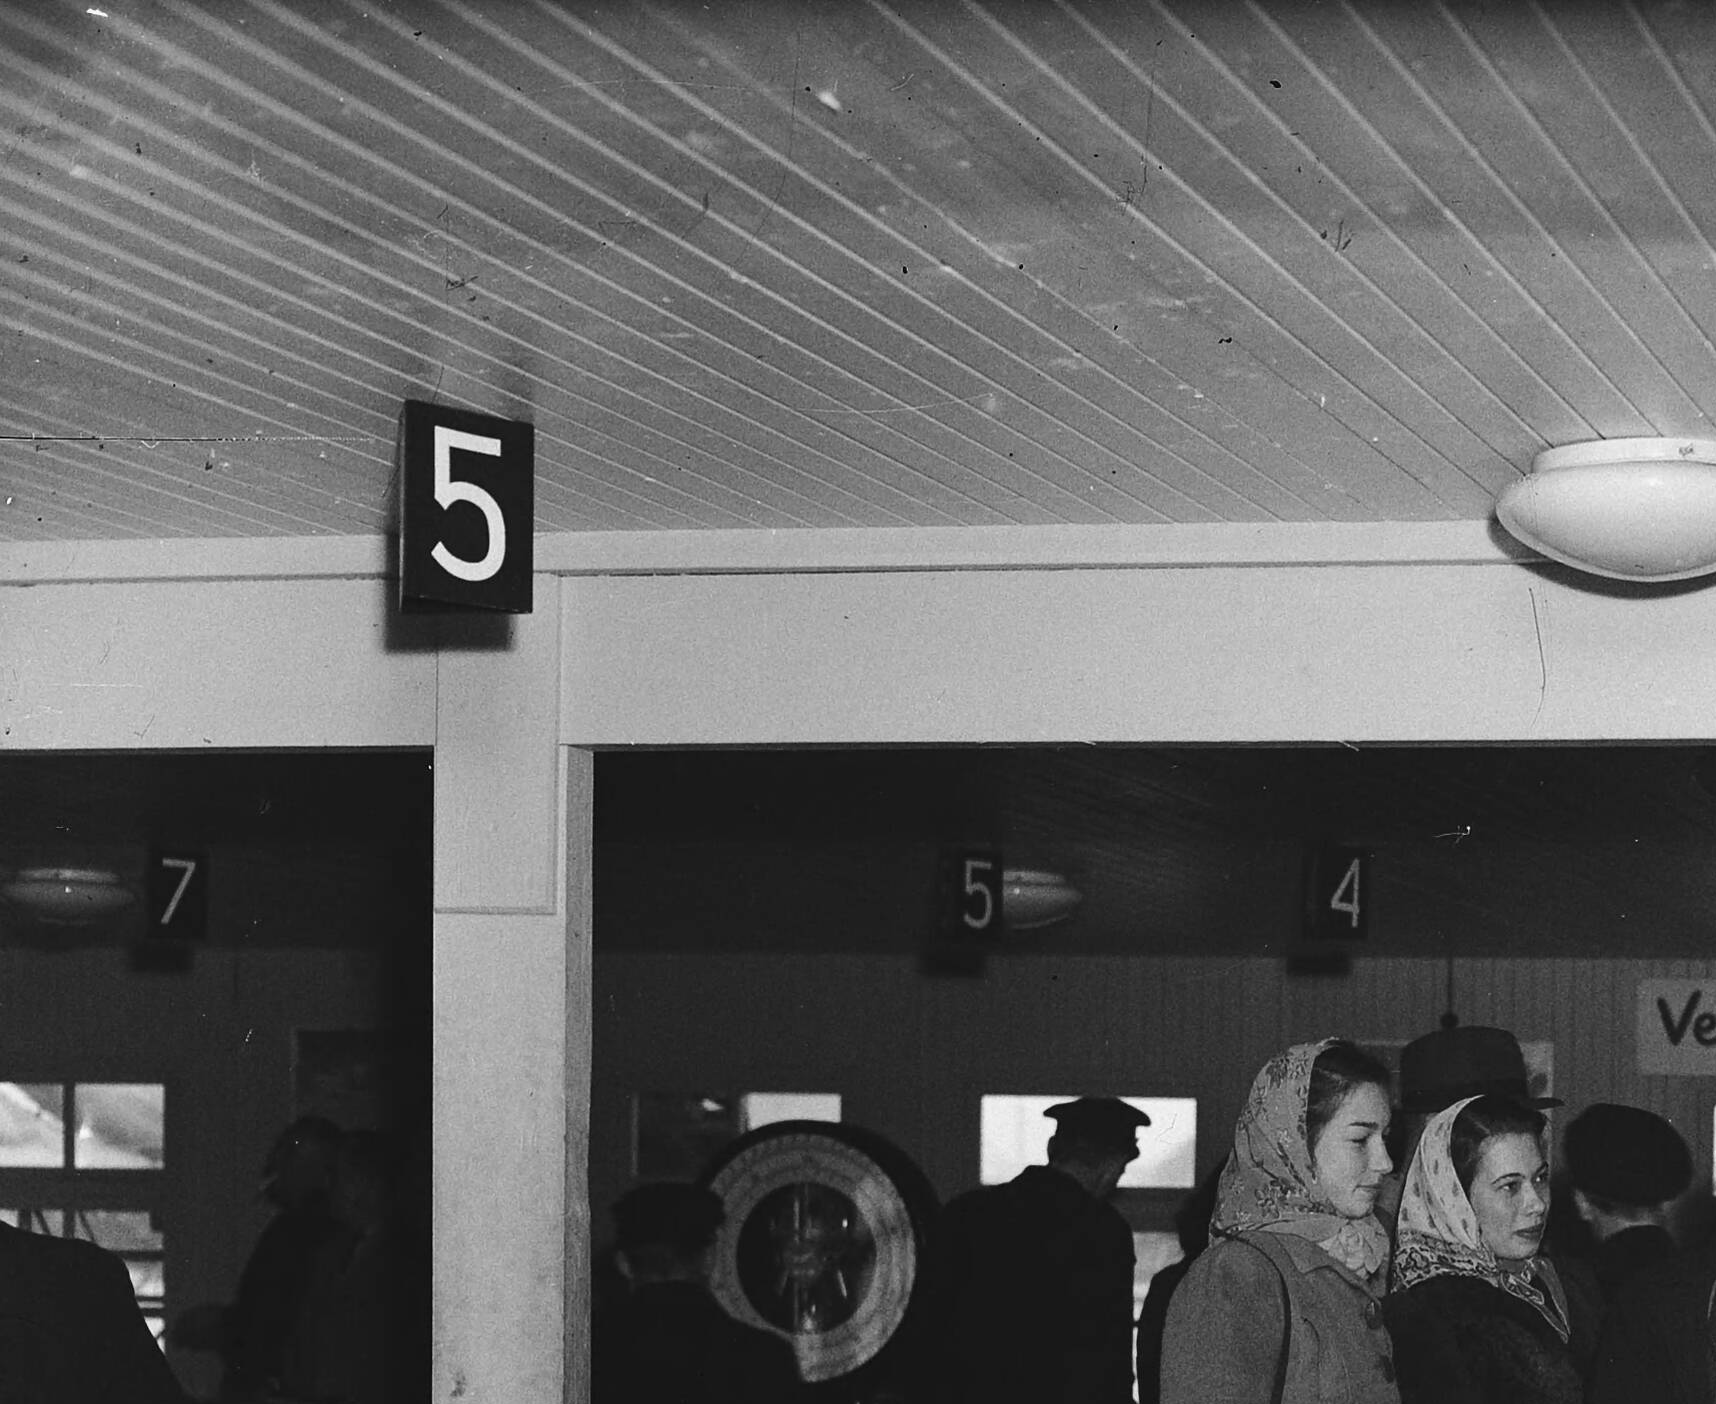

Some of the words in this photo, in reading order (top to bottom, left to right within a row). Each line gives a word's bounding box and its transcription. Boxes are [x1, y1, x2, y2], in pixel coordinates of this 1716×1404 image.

[431, 425, 506, 581] 5
[162, 857, 197, 925] 7
[963, 860, 992, 929] 5
[1330, 857, 1360, 929] 4
